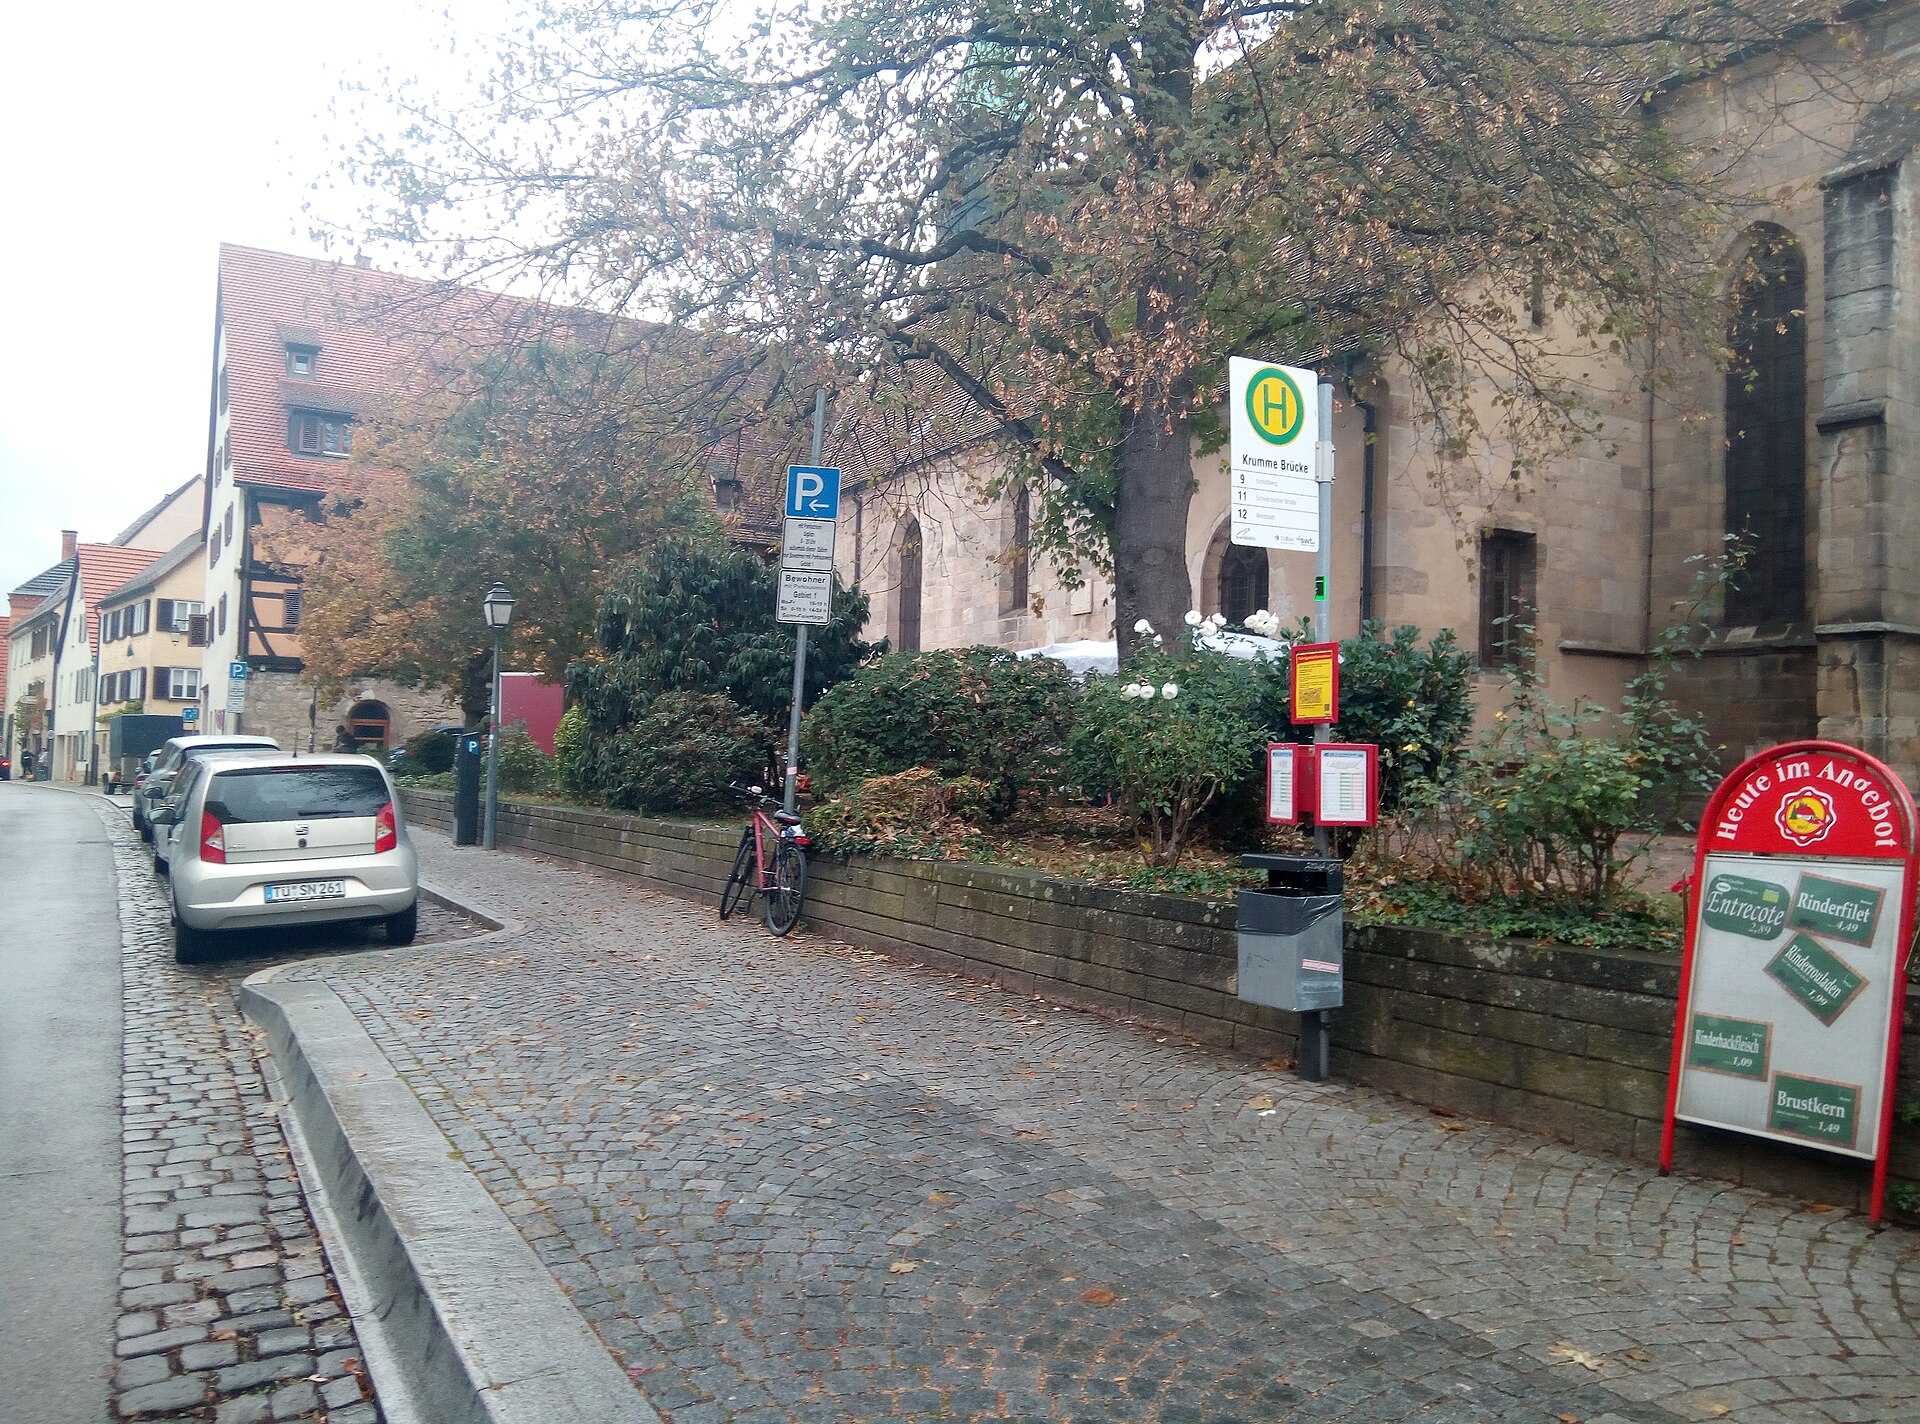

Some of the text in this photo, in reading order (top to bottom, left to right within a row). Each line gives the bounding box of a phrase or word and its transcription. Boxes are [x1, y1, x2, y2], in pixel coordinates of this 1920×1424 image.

[1264, 384, 1287, 429] H
[1242, 454, 1309, 474] Krumme Brücke
[1239, 474, 1245, 484] 9
[795, 473, 824, 510] P
[1238, 491, 1247, 501] 11
[1238, 509, 1248, 519] 12
[785, 574, 826, 584] Bewohner
[793, 591, 812, 599] Gebiet
[232, 664, 243, 677] P
[468, 741, 478, 752] P
[1716, 760, 1898, 847] Heute im Angebot
[274, 882, 343, 898] TÜ SN 261
[1706, 890, 1785, 926] Entrecote
[1797, 892, 1870, 923] Rinderfilet
[1748, 922, 1772, 935] 2,89
[1836, 920, 1859, 933] 4,49
[1784, 944, 1842, 999] Rinderrouladen
[1808, 989, 1828, 1006] 1,99
[1732, 1056, 1753, 1067] 1,09
[1777, 1090, 1846, 1119] Brustkern
[1818, 1121, 1841, 1134] 1,49
